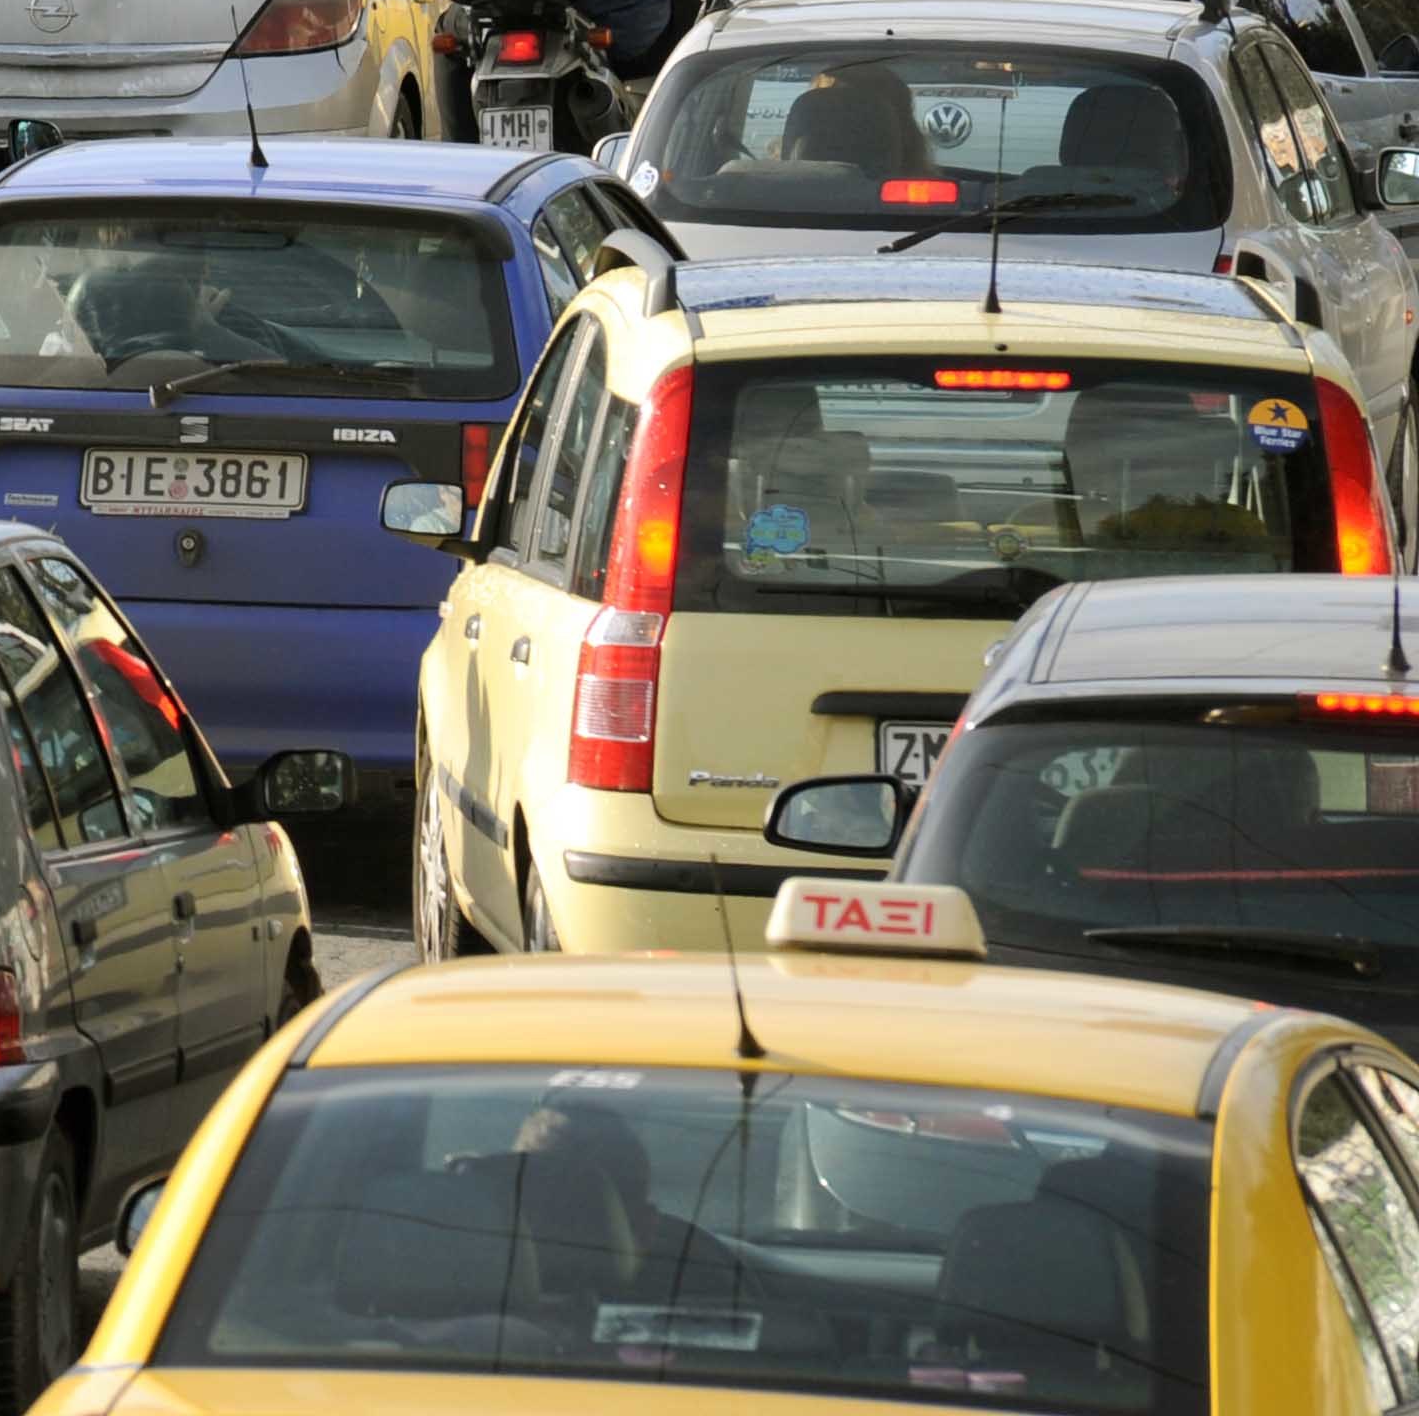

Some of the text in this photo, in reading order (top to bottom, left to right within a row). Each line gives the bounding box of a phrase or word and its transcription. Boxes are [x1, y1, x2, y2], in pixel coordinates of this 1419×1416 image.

[0, 417, 55, 432] SEAT
[332, 427, 397, 443] IBIZA
[689, 770, 780, 788] Panda
